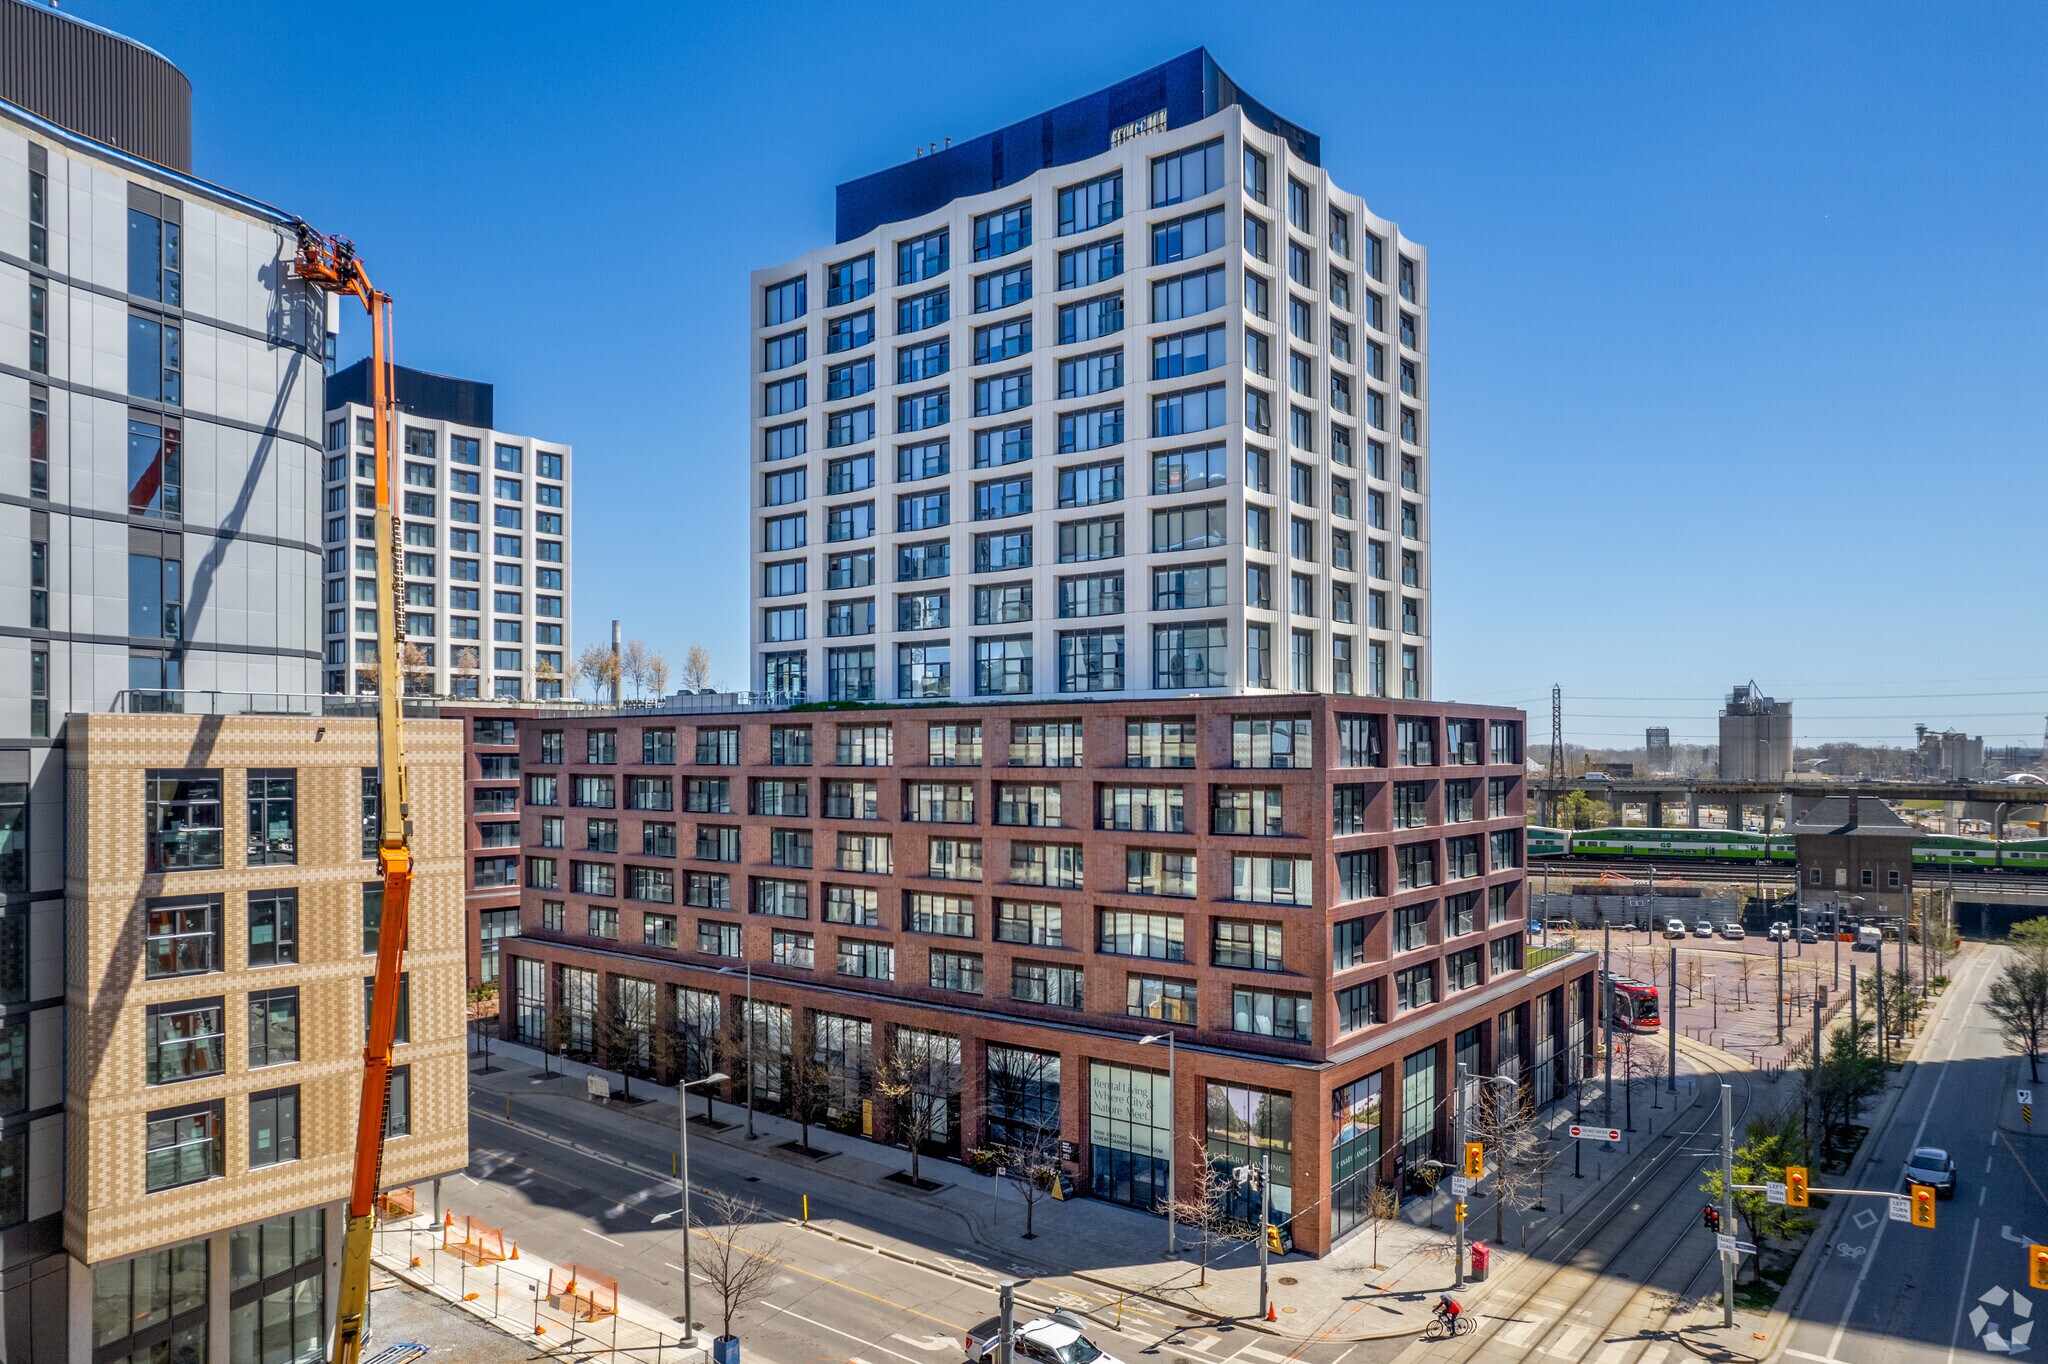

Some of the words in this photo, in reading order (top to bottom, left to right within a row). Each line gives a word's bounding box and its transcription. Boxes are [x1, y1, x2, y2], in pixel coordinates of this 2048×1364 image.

[1094, 1077, 1121, 1092] Rental
[1122, 1082, 1148, 1099] Living
[1094, 1089, 1125, 1104] Where
[1126, 1095, 1144, 1110] City
[1146, 1099, 1153, 1110] &
[1094, 1100, 1123, 1116] Nature
[1126, 1107, 1150, 1121] Meet.
[1213, 1151, 1245, 1165] CARY
[1249, 1159, 1285, 1173] LANING
